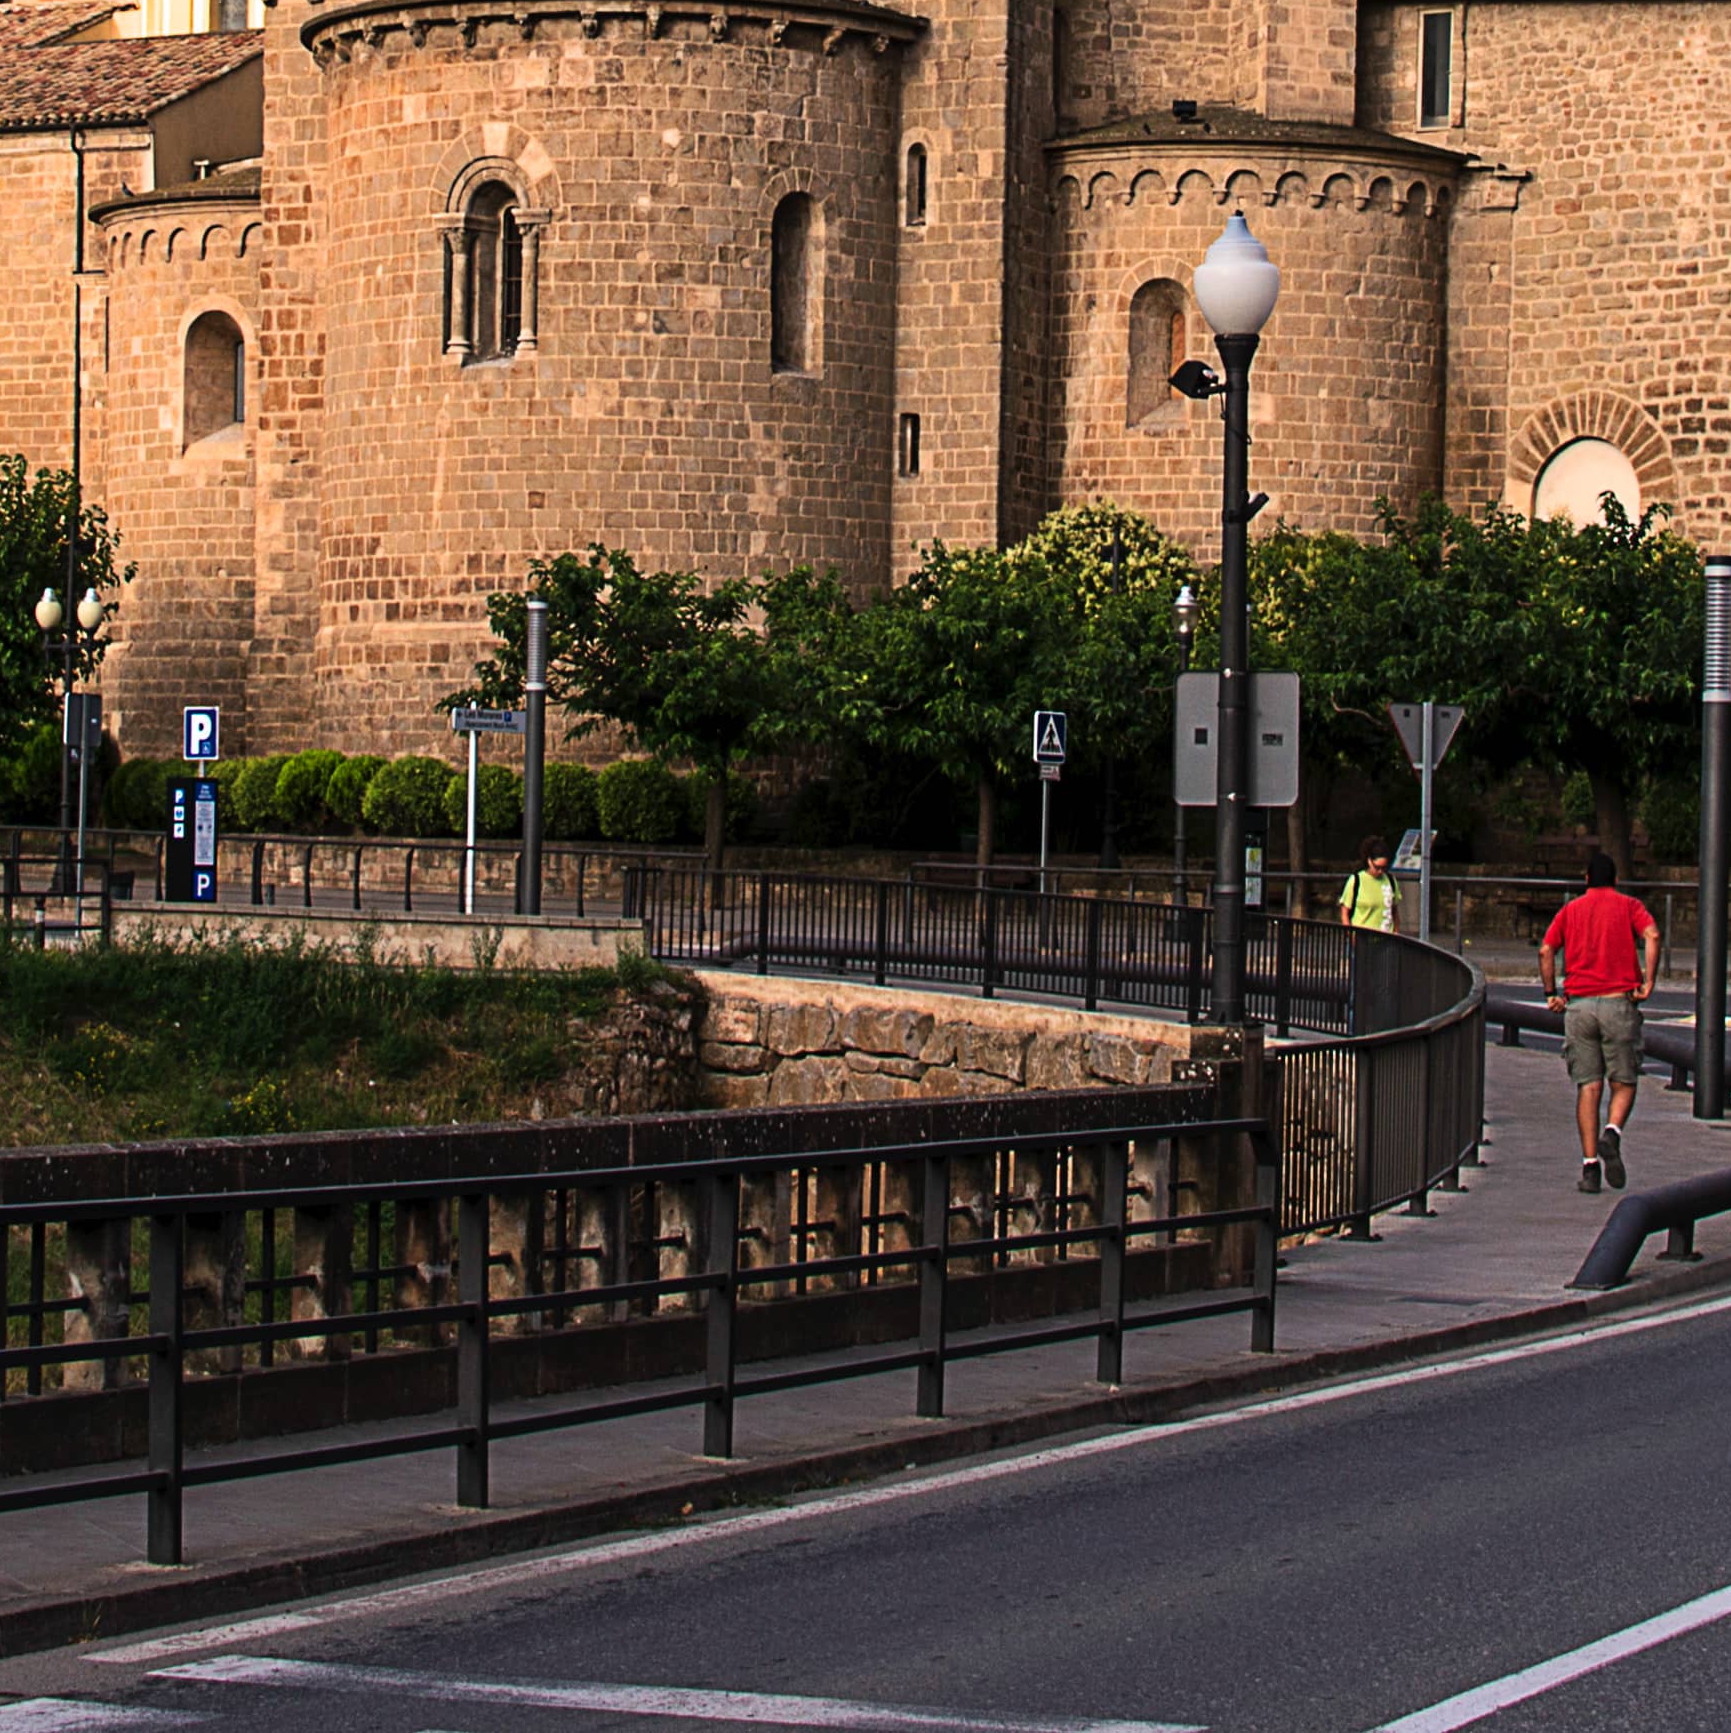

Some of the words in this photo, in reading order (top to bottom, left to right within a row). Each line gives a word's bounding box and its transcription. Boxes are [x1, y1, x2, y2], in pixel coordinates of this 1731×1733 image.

[190, 713, 212, 755] P
[175, 789, 183, 803] P
[197, 873, 210, 898] P
